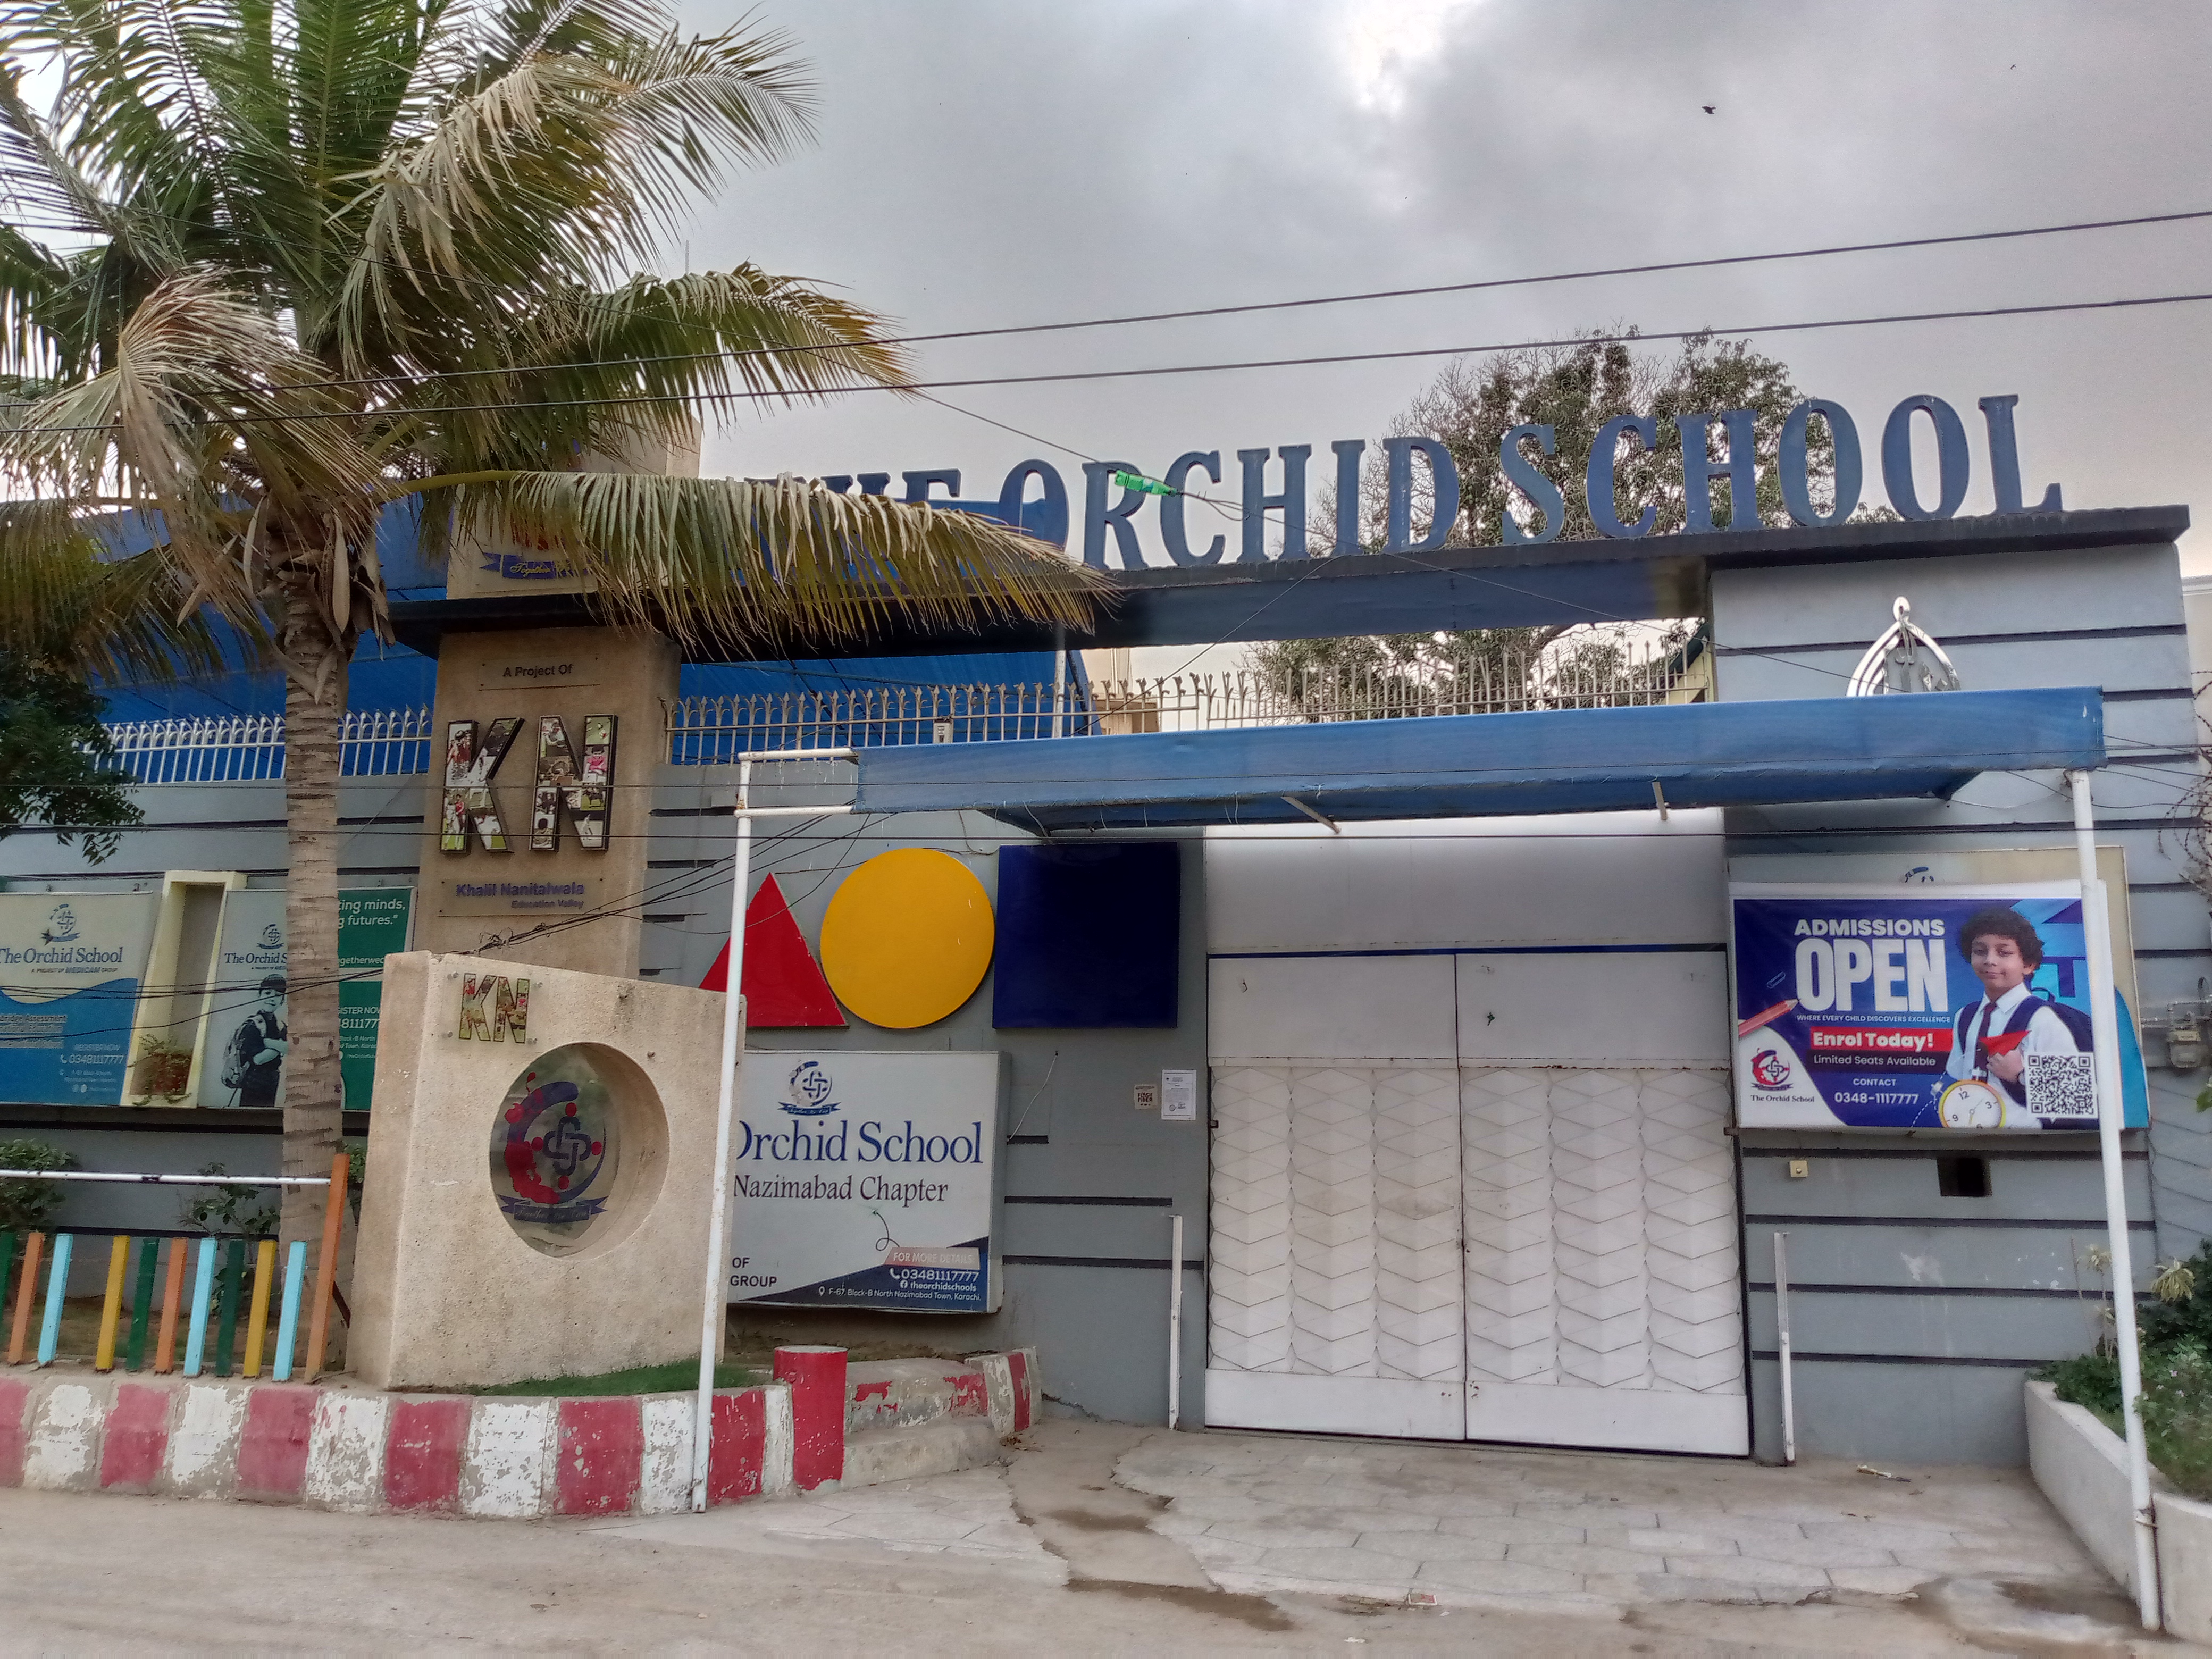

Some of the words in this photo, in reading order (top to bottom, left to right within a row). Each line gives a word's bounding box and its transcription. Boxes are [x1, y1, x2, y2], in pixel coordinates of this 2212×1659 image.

[998, 437, 1460, 570] ORCHID
[1499, 393, 2063, 546] SCHOOL
[502, 667, 512, 677] A
[515, 665, 556, 678] Project
[558, 664, 574, 675] Of
[456, 883, 497, 897] Khalil
[1794, 919, 1946, 936] ADMISSIONS
[23, 946, 74, 964] Orchid
[76, 946, 123, 963] School
[224, 952, 245, 963] The
[246, 952, 280, 963] Orchid
[1795, 937, 1949, 1012] OPEN
[339, 1018, 380, 1028] 811177
[1813, 1032, 1862, 1046] Enrol
[1864, 1032, 1934, 1052] Today!
[1814, 1054, 1852, 1065] Limited
[1854, 1055, 1884, 1065] Seats
[1887, 1056, 1936, 1066] Available
[1853, 1078, 1897, 1087] CONTACT
[1834, 1092, 1919, 1105] 0348-1117777
[1958, 1091, 1970, 1100] 12
[858, 1120, 984, 1164] School
[733, 1174, 853, 1200] Nazimabad
[859, 1174, 950, 1208] Chapter
[732, 1257, 750, 1268] OF
[893, 1252, 911, 1262] FOR
[912, 1252, 937, 1263] MORE
[939, 1253, 973, 1264] DETAILS
[730, 1275, 777, 1287] GROUP
[910, 1281, 977, 1292] theorchidschools
[874, 1289, 894, 1297] North
[894, 1290, 932, 1299] Nazimabad
